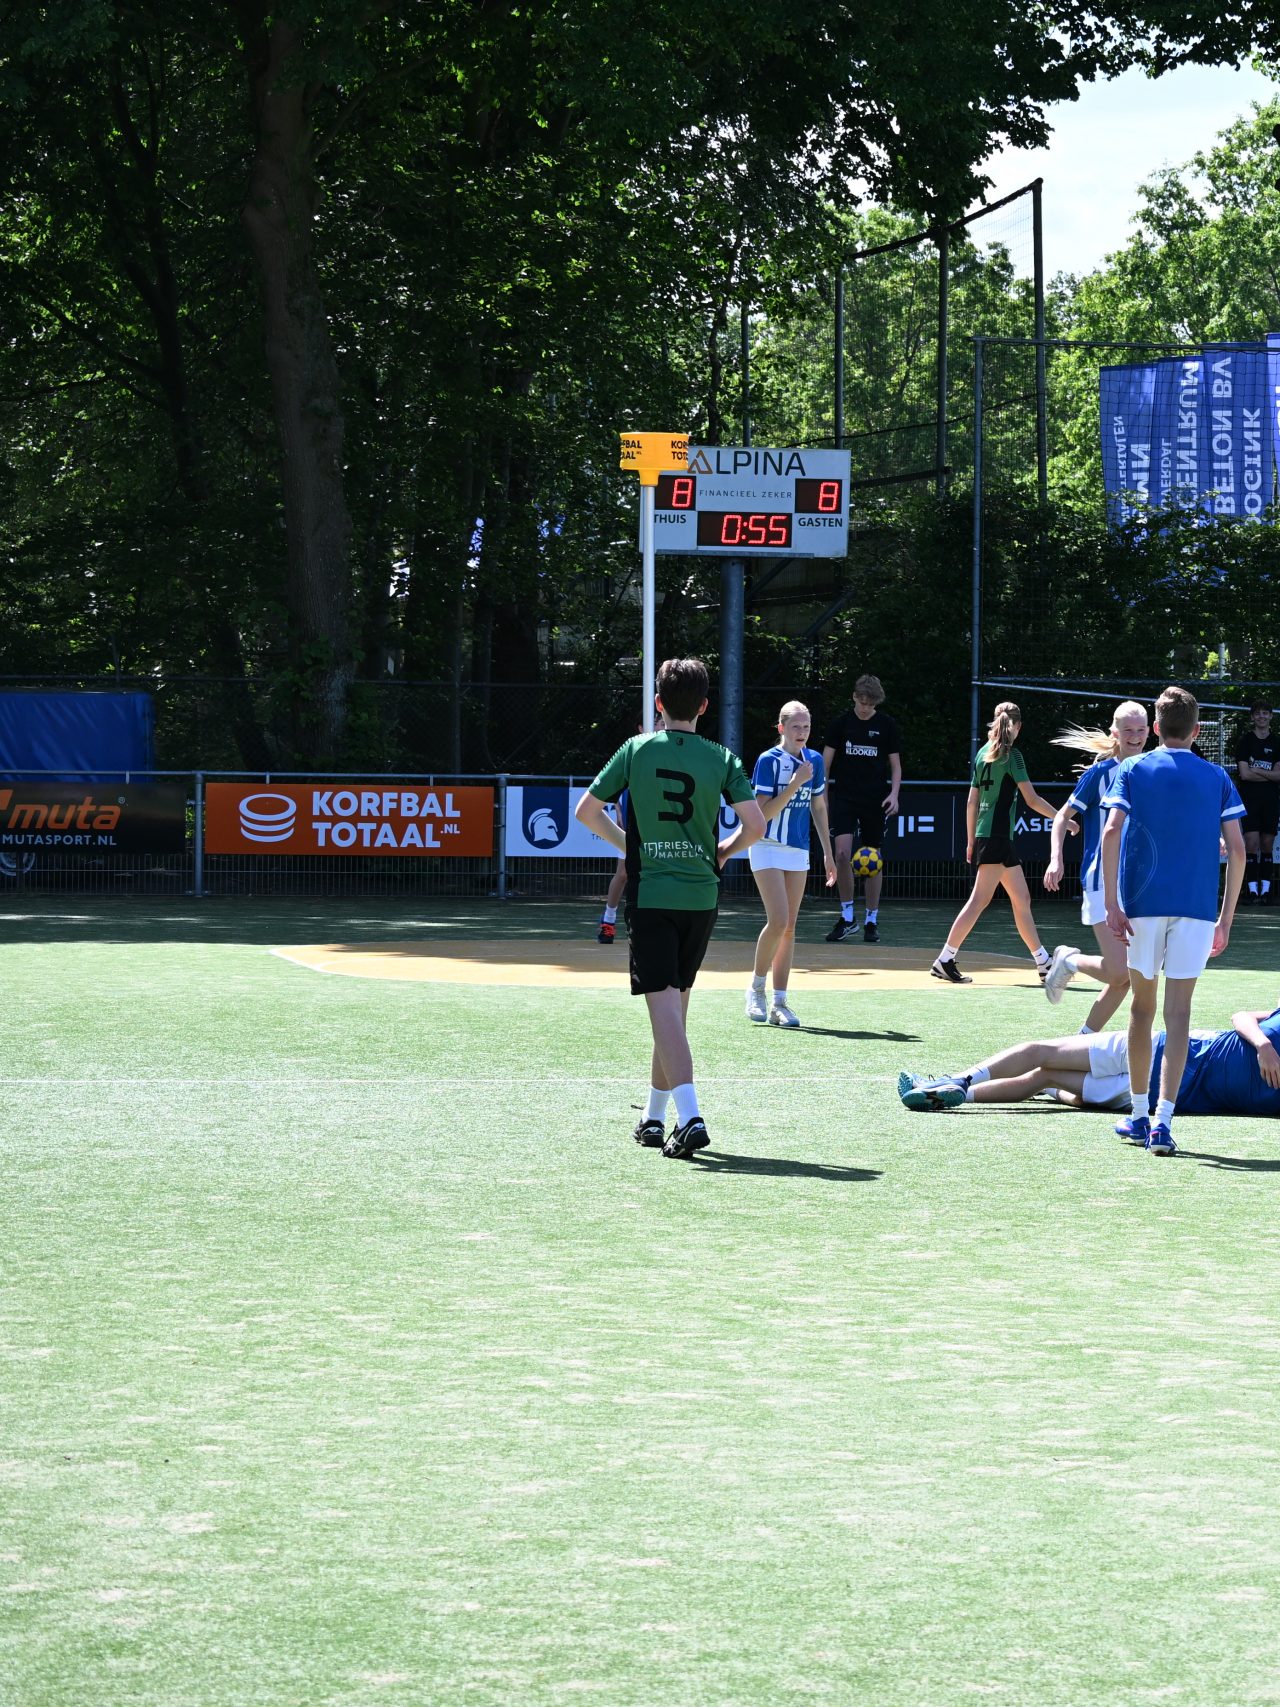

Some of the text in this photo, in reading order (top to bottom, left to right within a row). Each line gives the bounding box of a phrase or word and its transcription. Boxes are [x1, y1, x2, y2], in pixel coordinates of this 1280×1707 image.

[688, 449, 807, 476] ALPINA
[672, 478, 693, 508] 8
[699, 489, 793, 499] FINANCIEEL ZEKER
[818, 482, 839, 511] 8
[653, 513, 686, 524] THUIS
[721, 514, 788, 544] 0:55
[798, 517, 843, 528] GASTEN
[312, 790, 461, 818] KORFBAL
[655, 768, 696, 824] 3
[7, 796, 122, 830] muta
[2, 834, 118, 846] MUTASPORT.NL
[312, 821, 441, 848] TOTAAL
